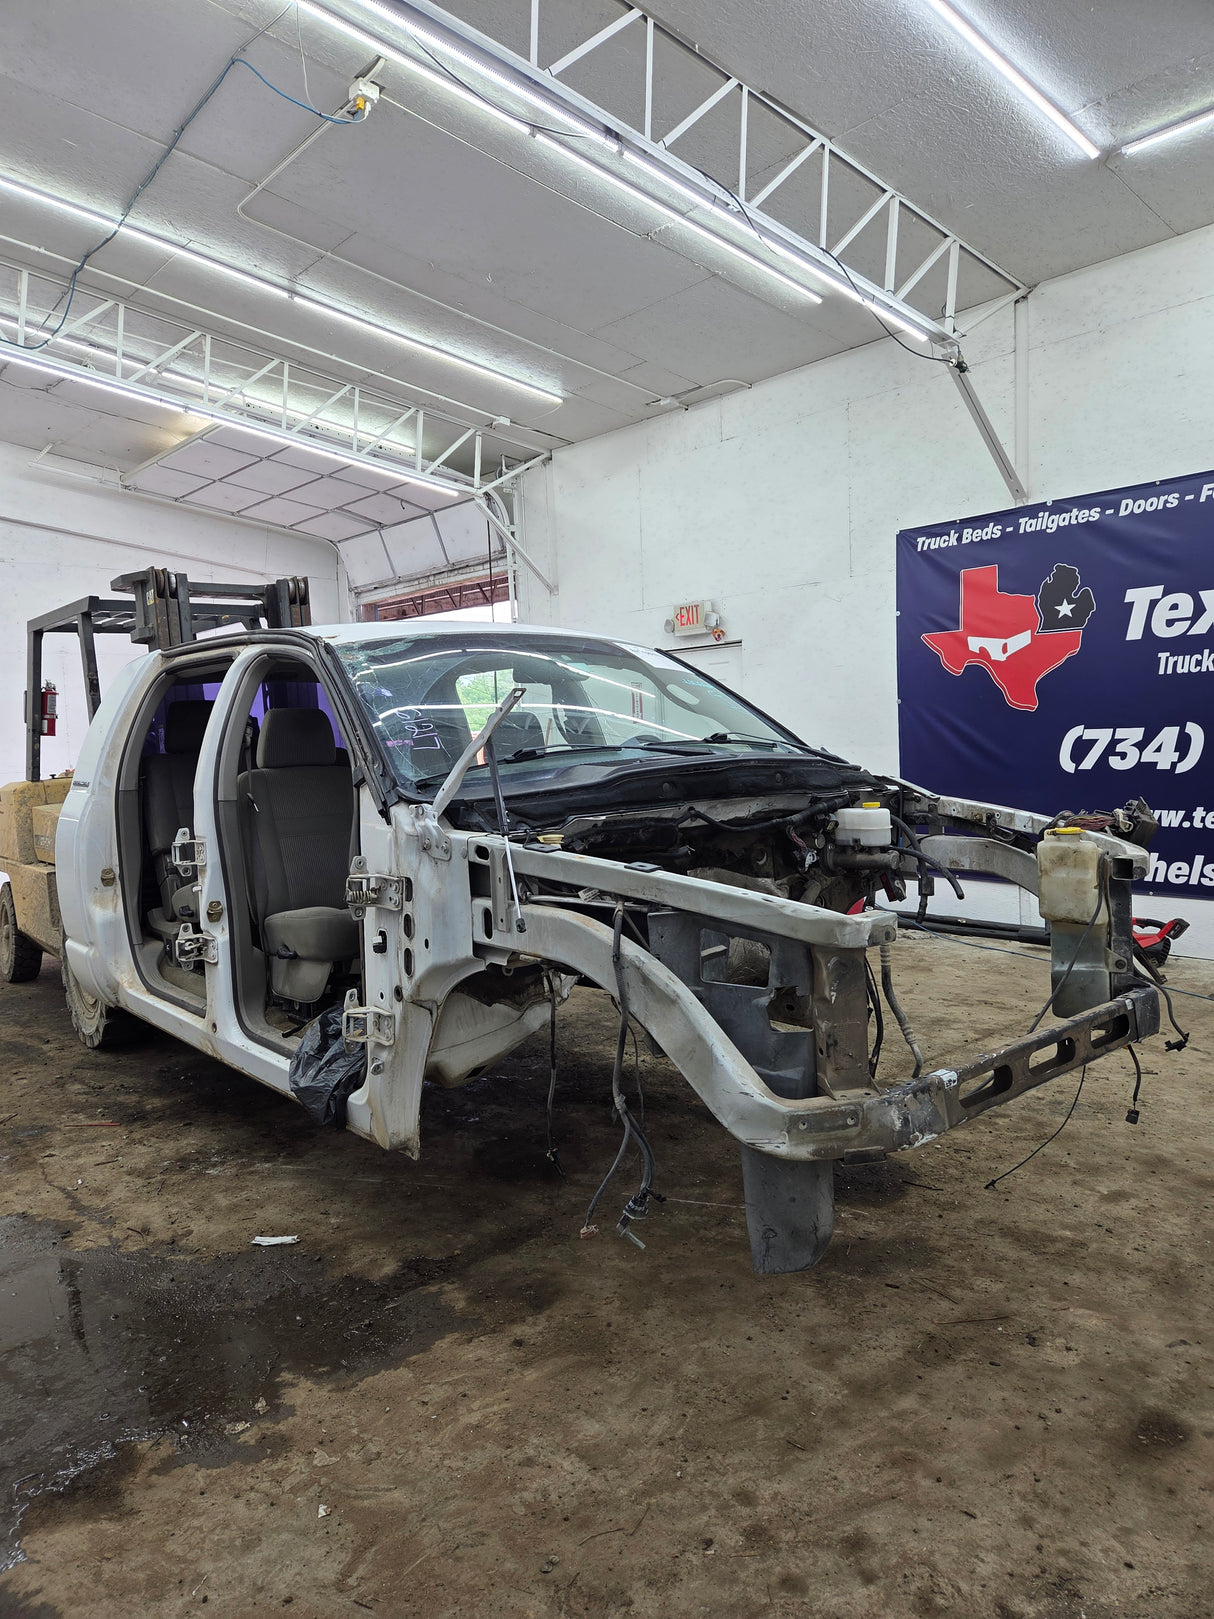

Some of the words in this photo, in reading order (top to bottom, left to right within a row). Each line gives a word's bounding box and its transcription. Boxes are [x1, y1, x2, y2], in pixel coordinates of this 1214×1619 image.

[916, 529, 960, 552] Truck
[961, 522, 1003, 544] Beds
[1018, 507, 1102, 534] Tailgates
[1118, 492, 1180, 517] Doors
[1199, 483, 1214, 503] F
[679, 604, 700, 627] EXIT
[1124, 584, 1214, 641] Tex
[1157, 648, 1214, 675] Truck
[1058, 721, 1205, 774] (734)
